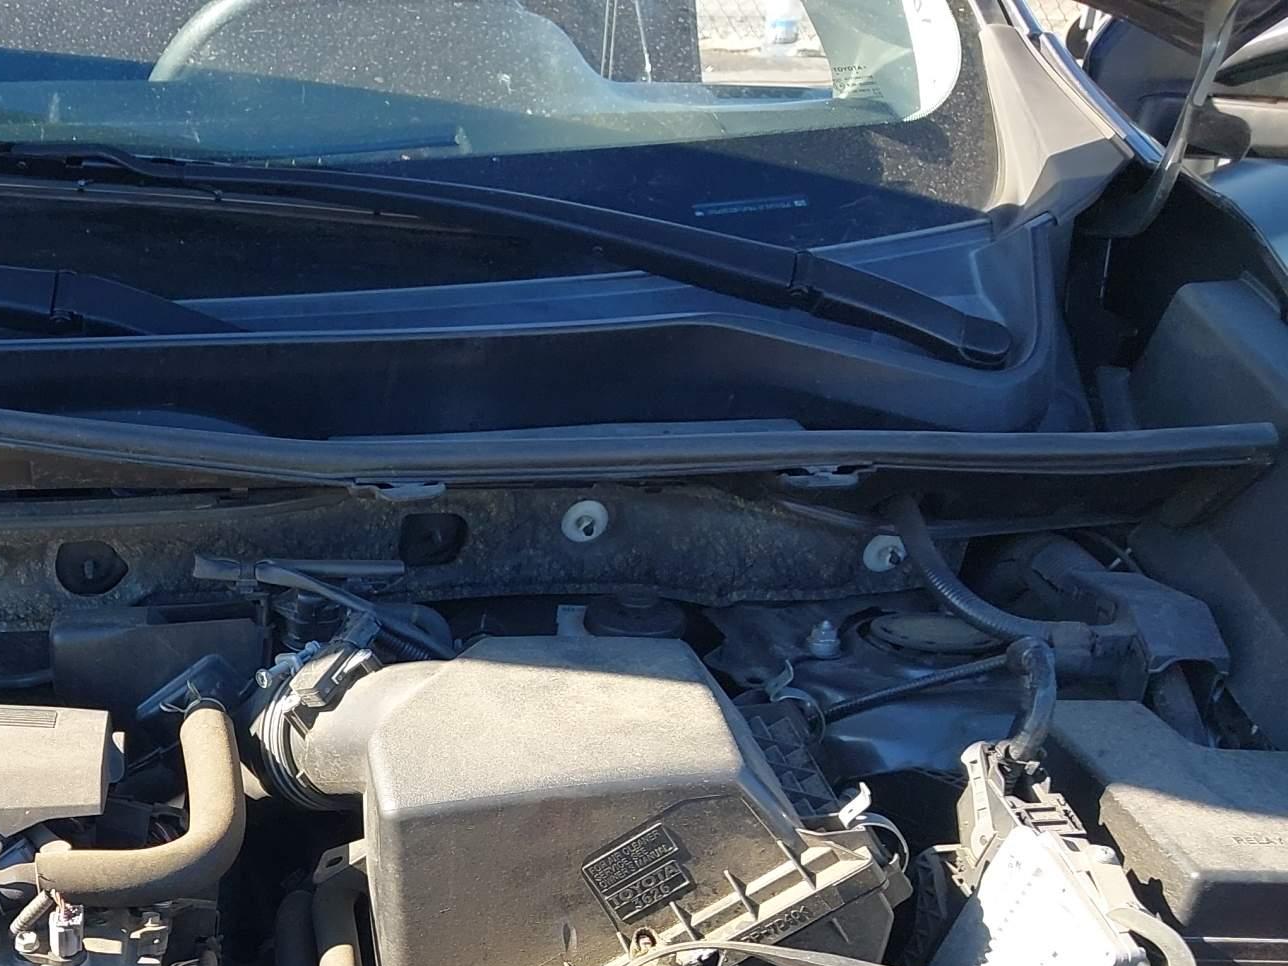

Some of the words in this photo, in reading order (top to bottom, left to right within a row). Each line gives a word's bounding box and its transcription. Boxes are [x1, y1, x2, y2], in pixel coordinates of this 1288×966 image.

[833, 65, 862, 73] TOYOTA
[1231, 836, 1285, 846] RELAY
[588, 859, 608, 875] FOR
[607, 850, 623, 866] AIR
[622, 829, 662, 856] CLEANER
[631, 847, 649, 860] SEE
[608, 864, 678, 906] TOYOTA
[631, 883, 671, 909] 3626
